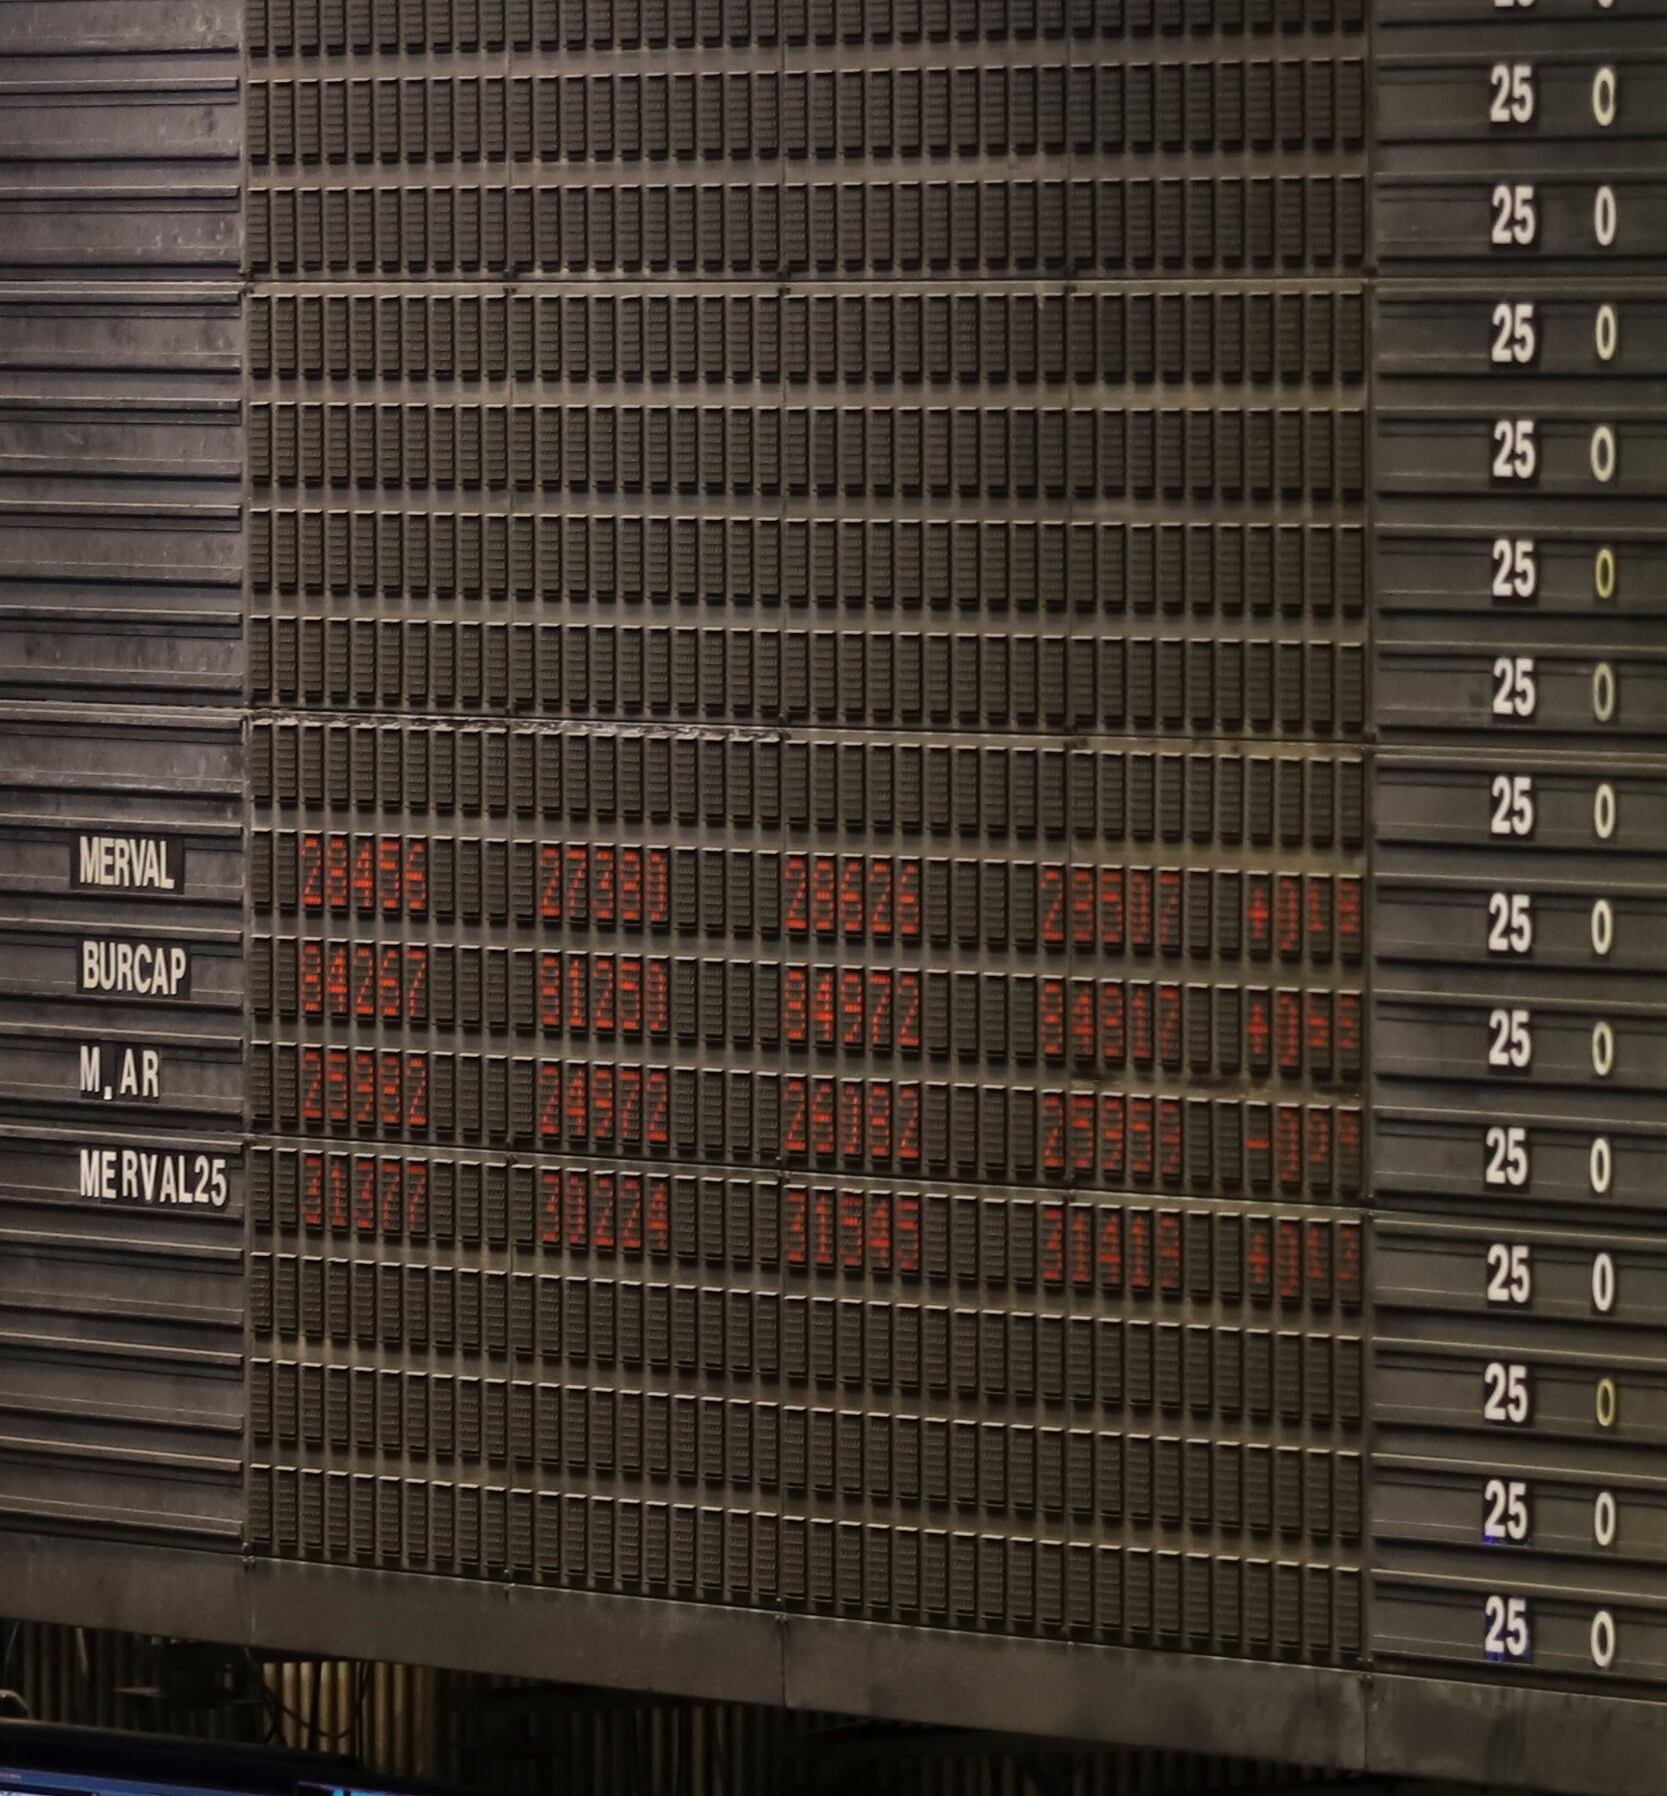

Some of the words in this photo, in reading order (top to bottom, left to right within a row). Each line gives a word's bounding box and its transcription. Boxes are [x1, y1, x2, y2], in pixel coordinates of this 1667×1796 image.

[1490, 64, 1533, 122] 25
[1492, 185, 1535, 244] 25
[1492, 304, 1534, 362] 25
[1493, 420, 1535, 478] 25
[1493, 539, 1535, 596] 25
[1493, 658, 1535, 715] 25
[1491, 776, 1533, 834] 25
[79, 835, 175, 890] MERVAL
[1489, 893, 1531, 952] 25
[83, 942, 187, 996] BURCAP
[1489, 1010, 1530, 1066] 25
[79, 1149, 227, 1207] MERVAL25
[1486, 1128, 1527, 1185] 25
[1488, 1245, 1529, 1302] 25
[1484, 1363, 1527, 1422] 25
[1484, 1480, 1527, 1545] 25
[1485, 1596, 1527, 1655] 25
